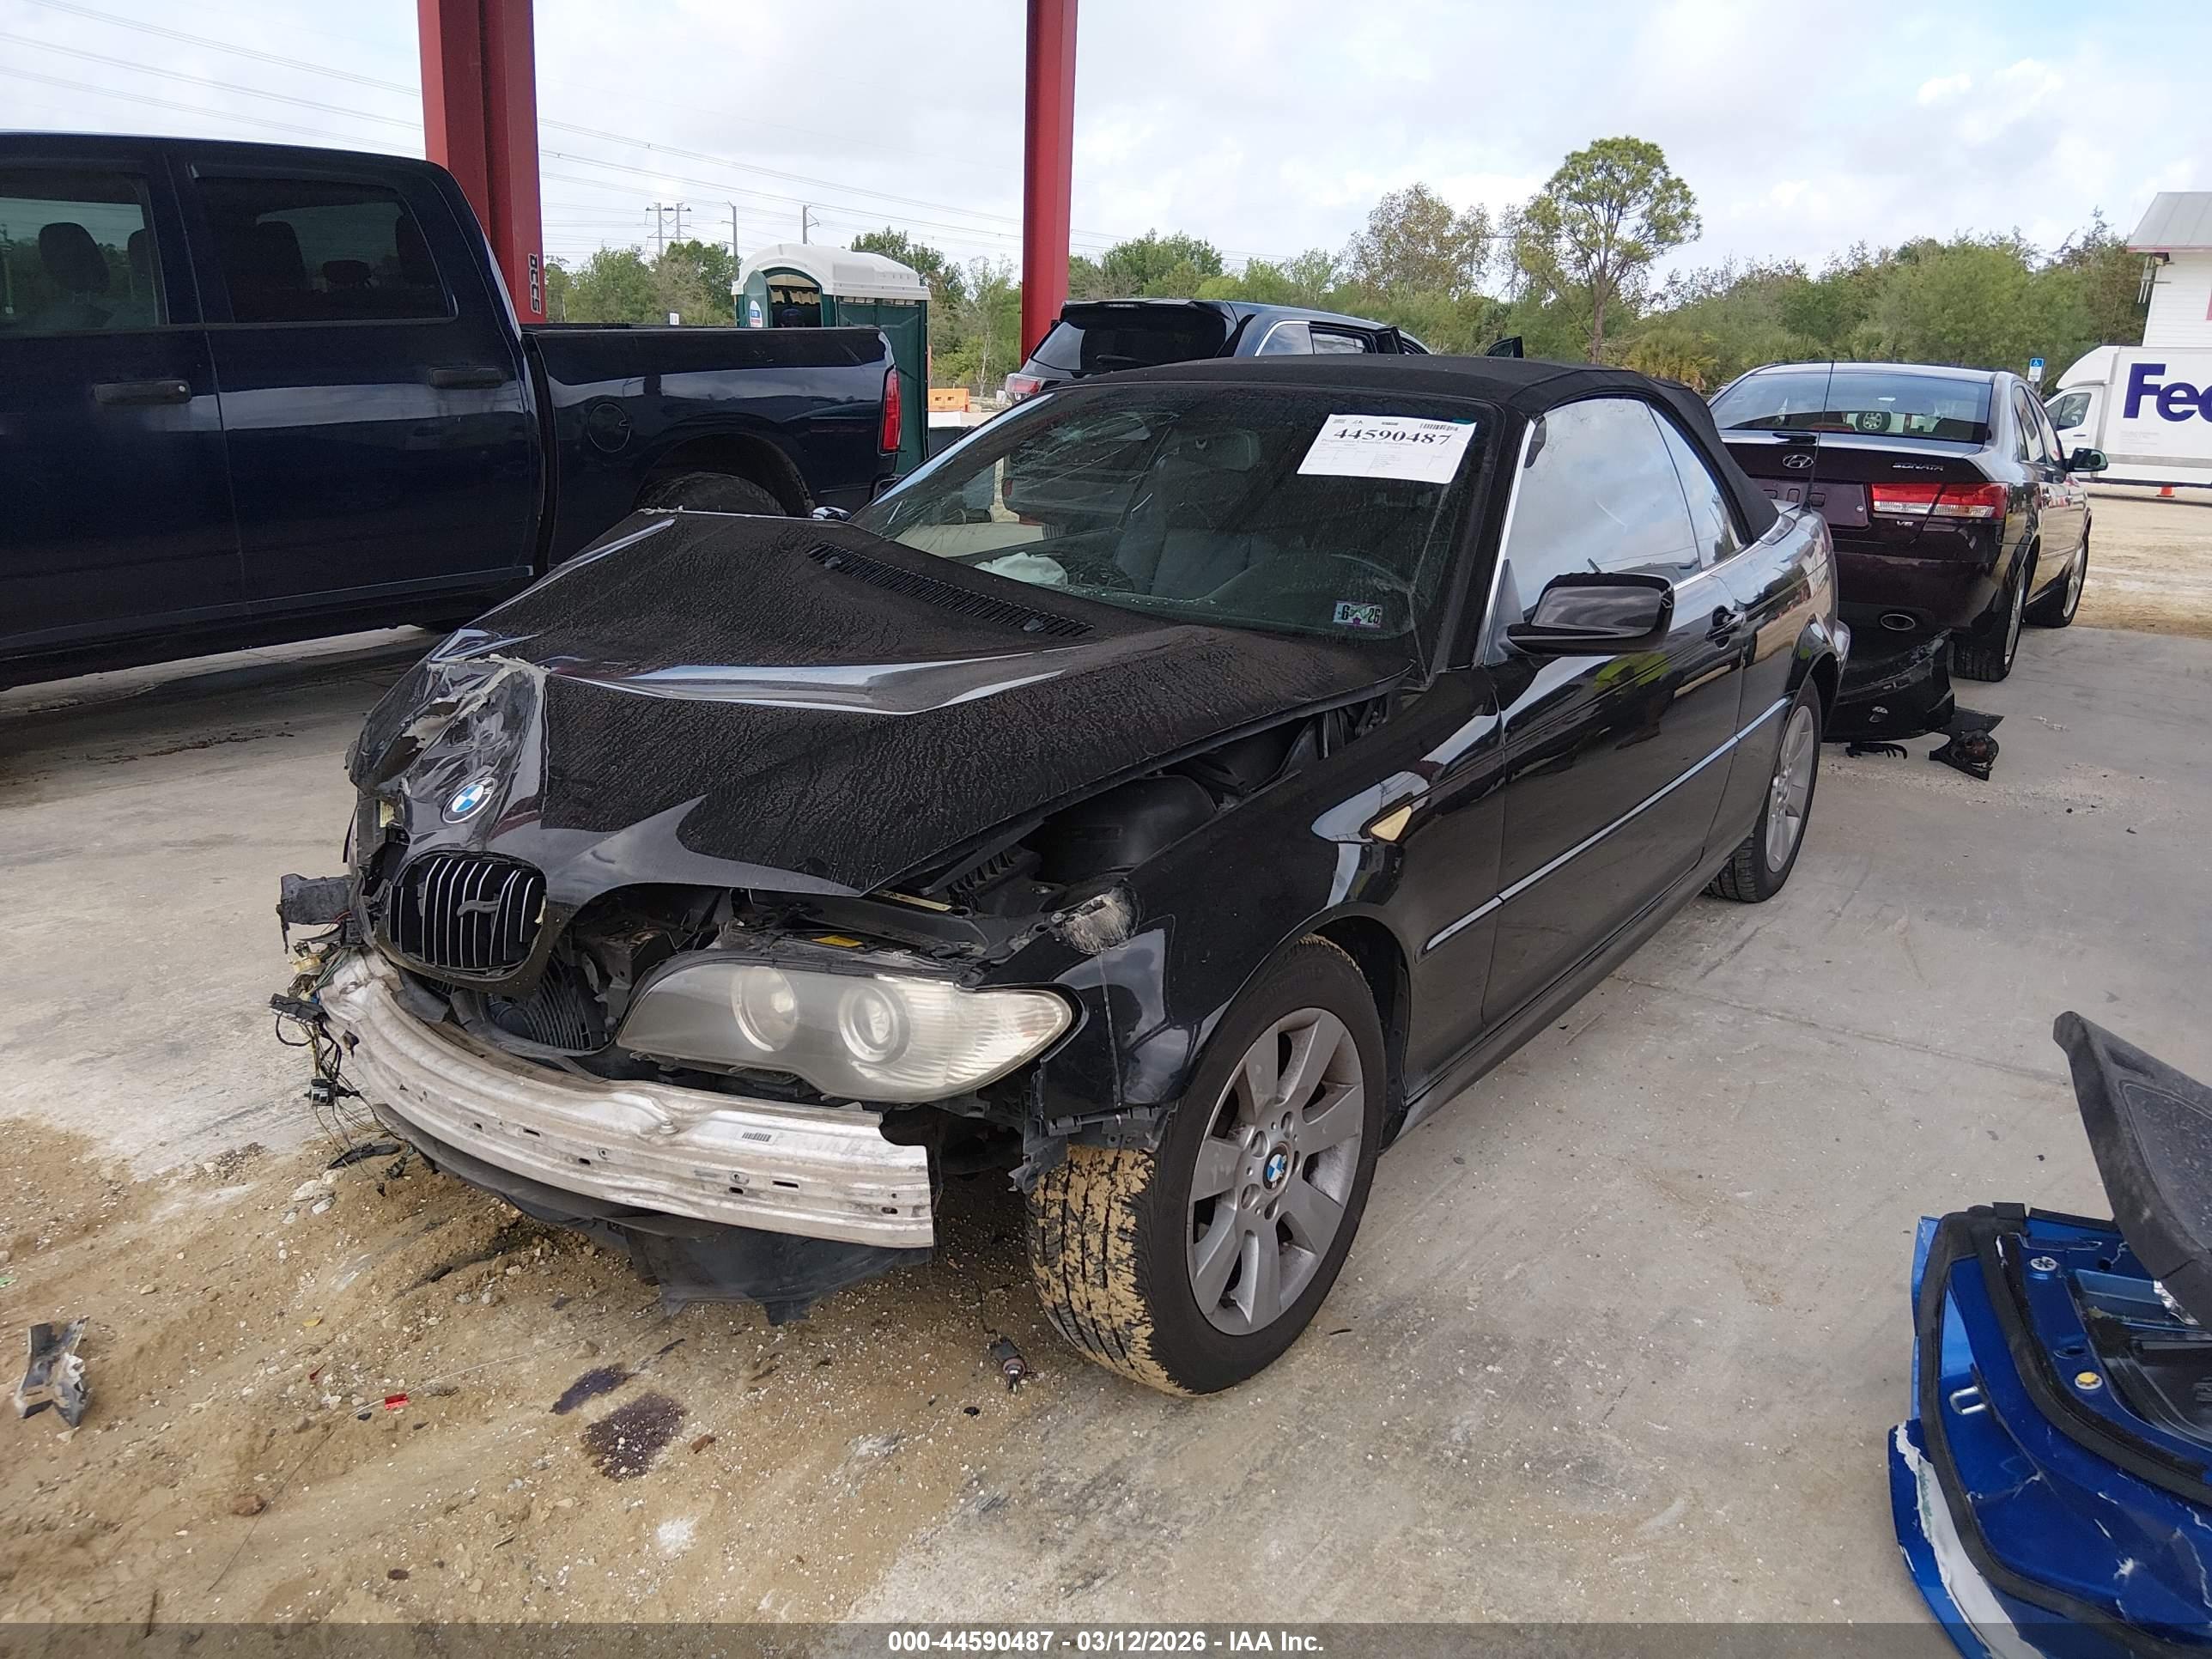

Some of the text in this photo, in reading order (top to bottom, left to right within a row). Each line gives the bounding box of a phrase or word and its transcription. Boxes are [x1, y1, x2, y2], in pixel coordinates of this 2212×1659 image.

[1334, 428, 1451, 446] 44590487
[1341, 605, 1381, 623] 6 26
